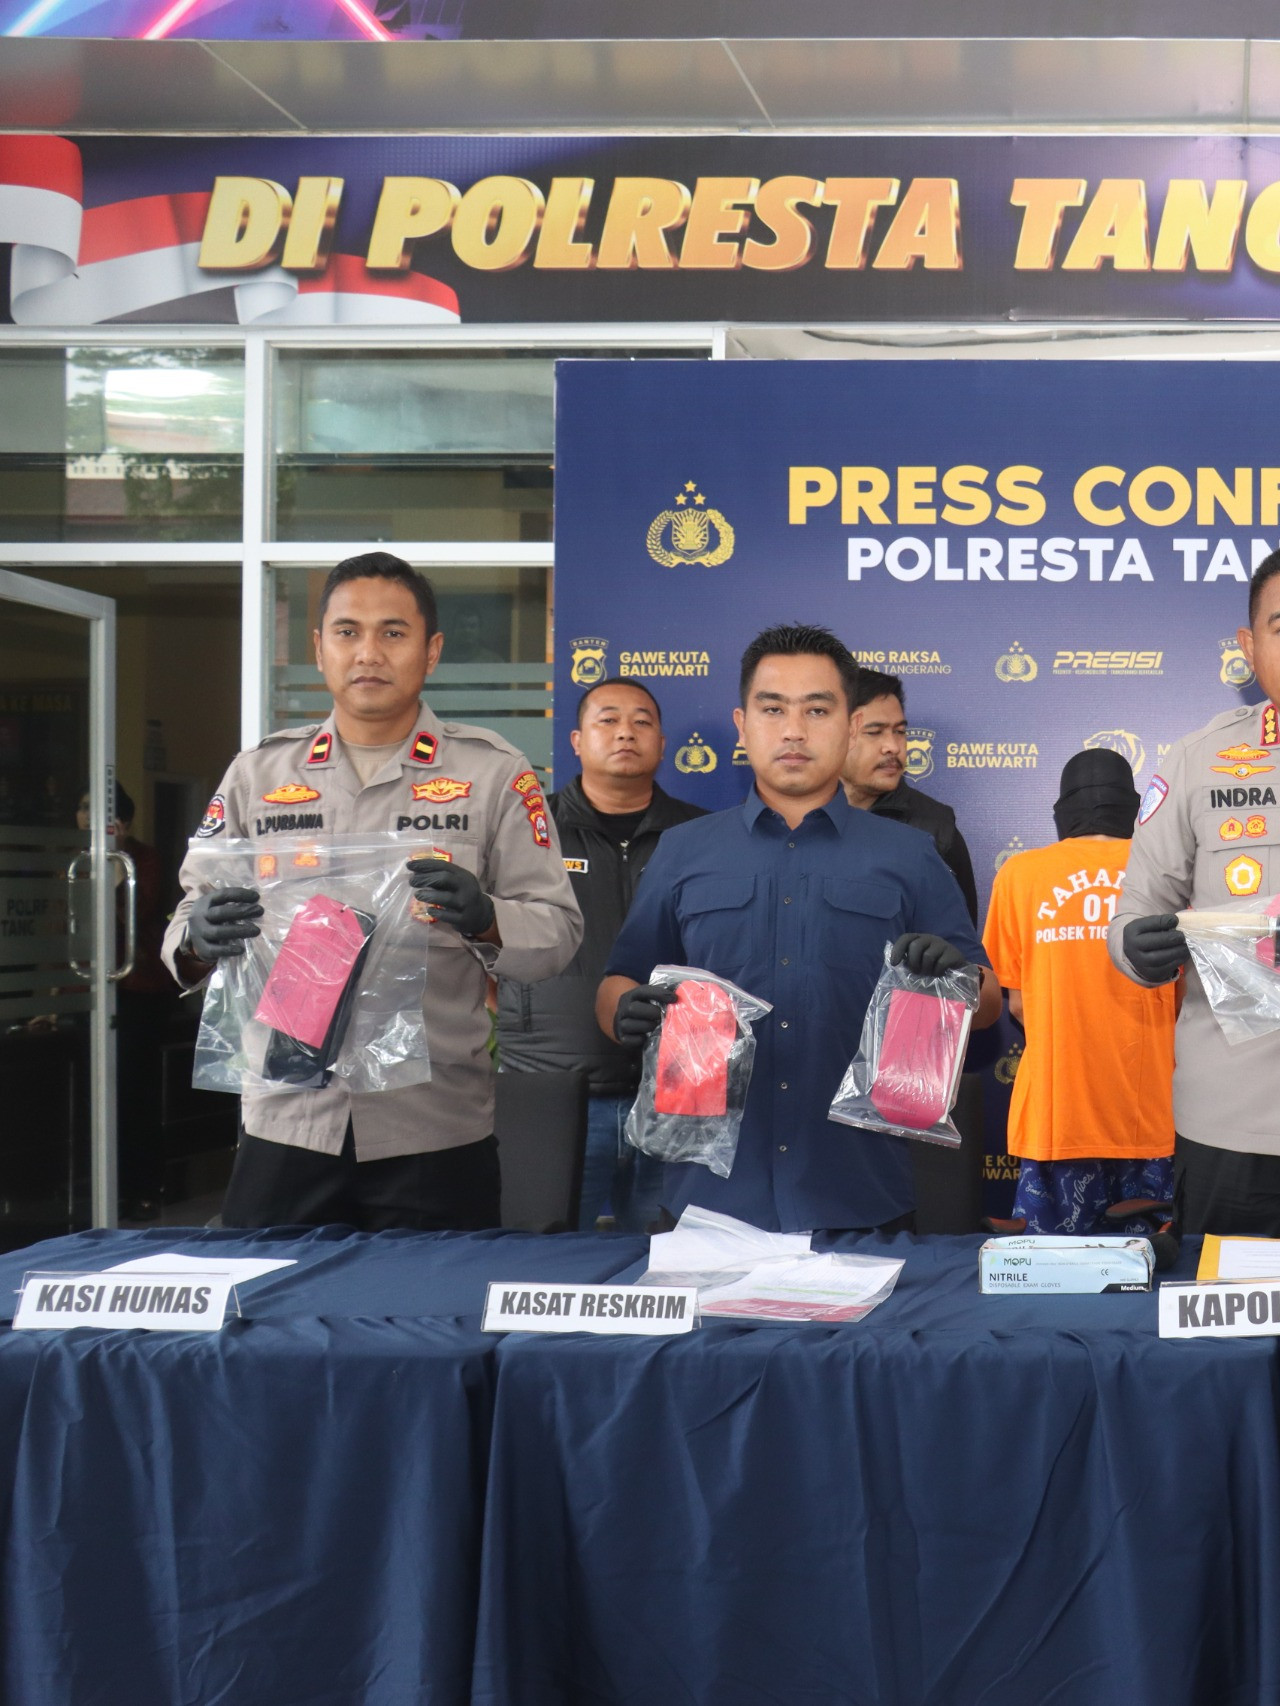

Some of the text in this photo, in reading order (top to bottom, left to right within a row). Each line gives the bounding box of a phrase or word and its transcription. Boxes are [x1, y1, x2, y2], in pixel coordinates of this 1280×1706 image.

[198, 175, 344, 271] DI
[366, 175, 963, 272] POLRESTA
[789, 464, 1047, 527] PRESS
[848, 536, 1154, 582] POLRESTA
[619, 651, 710, 664] GAWE KUTA
[852, 651, 941, 663] UNG RAKSA
[1053, 651, 1163, 669] PRESISI
[619, 664, 709, 677] BALUWARTI
[884, 664, 952, 675] TANGERANG
[947, 743, 1039, 755] GAWE KUTA
[947, 756, 1037, 768] BALUWARTI
[1210, 786, 1277, 809] INDRA
[397, 814, 469, 831] POLRI
[1083, 893, 1117, 922] 01
[1036, 925, 1085, 944] POLSEK
[1003, 1257, 1032, 1267] MOPU
[989, 1273, 1028, 1282] NITRILE
[35, 1284, 212, 1315] KASI HUMAS
[499, 1291, 687, 1319] KASAT RESKRIM
